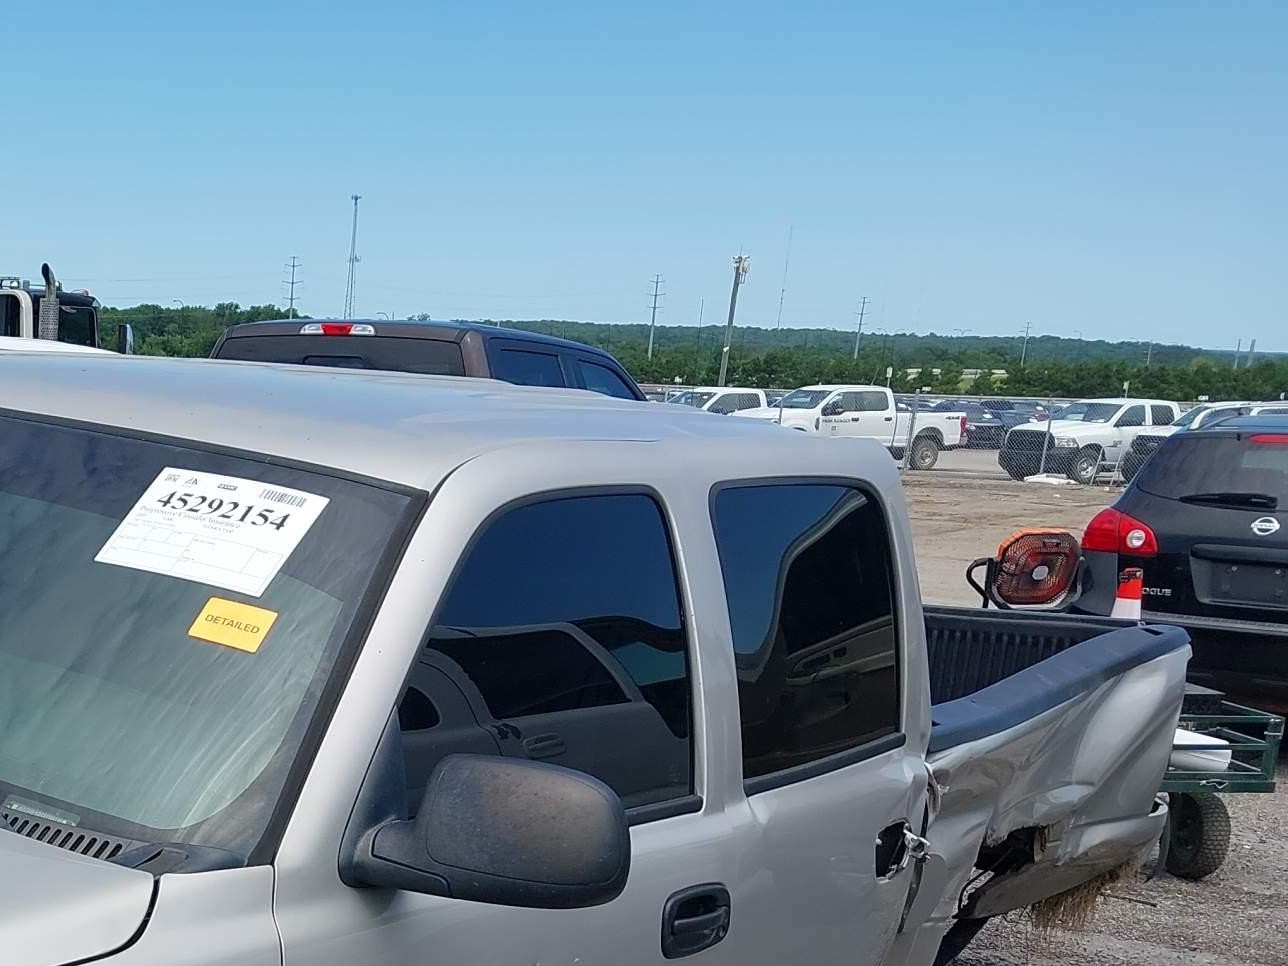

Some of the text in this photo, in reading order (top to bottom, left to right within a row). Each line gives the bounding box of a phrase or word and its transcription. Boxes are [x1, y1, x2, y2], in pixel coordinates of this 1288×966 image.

[157, 490, 291, 531] 45292154
[1142, 587, 1173, 597] OGUE
[204, 613, 260, 635] DETAILED
